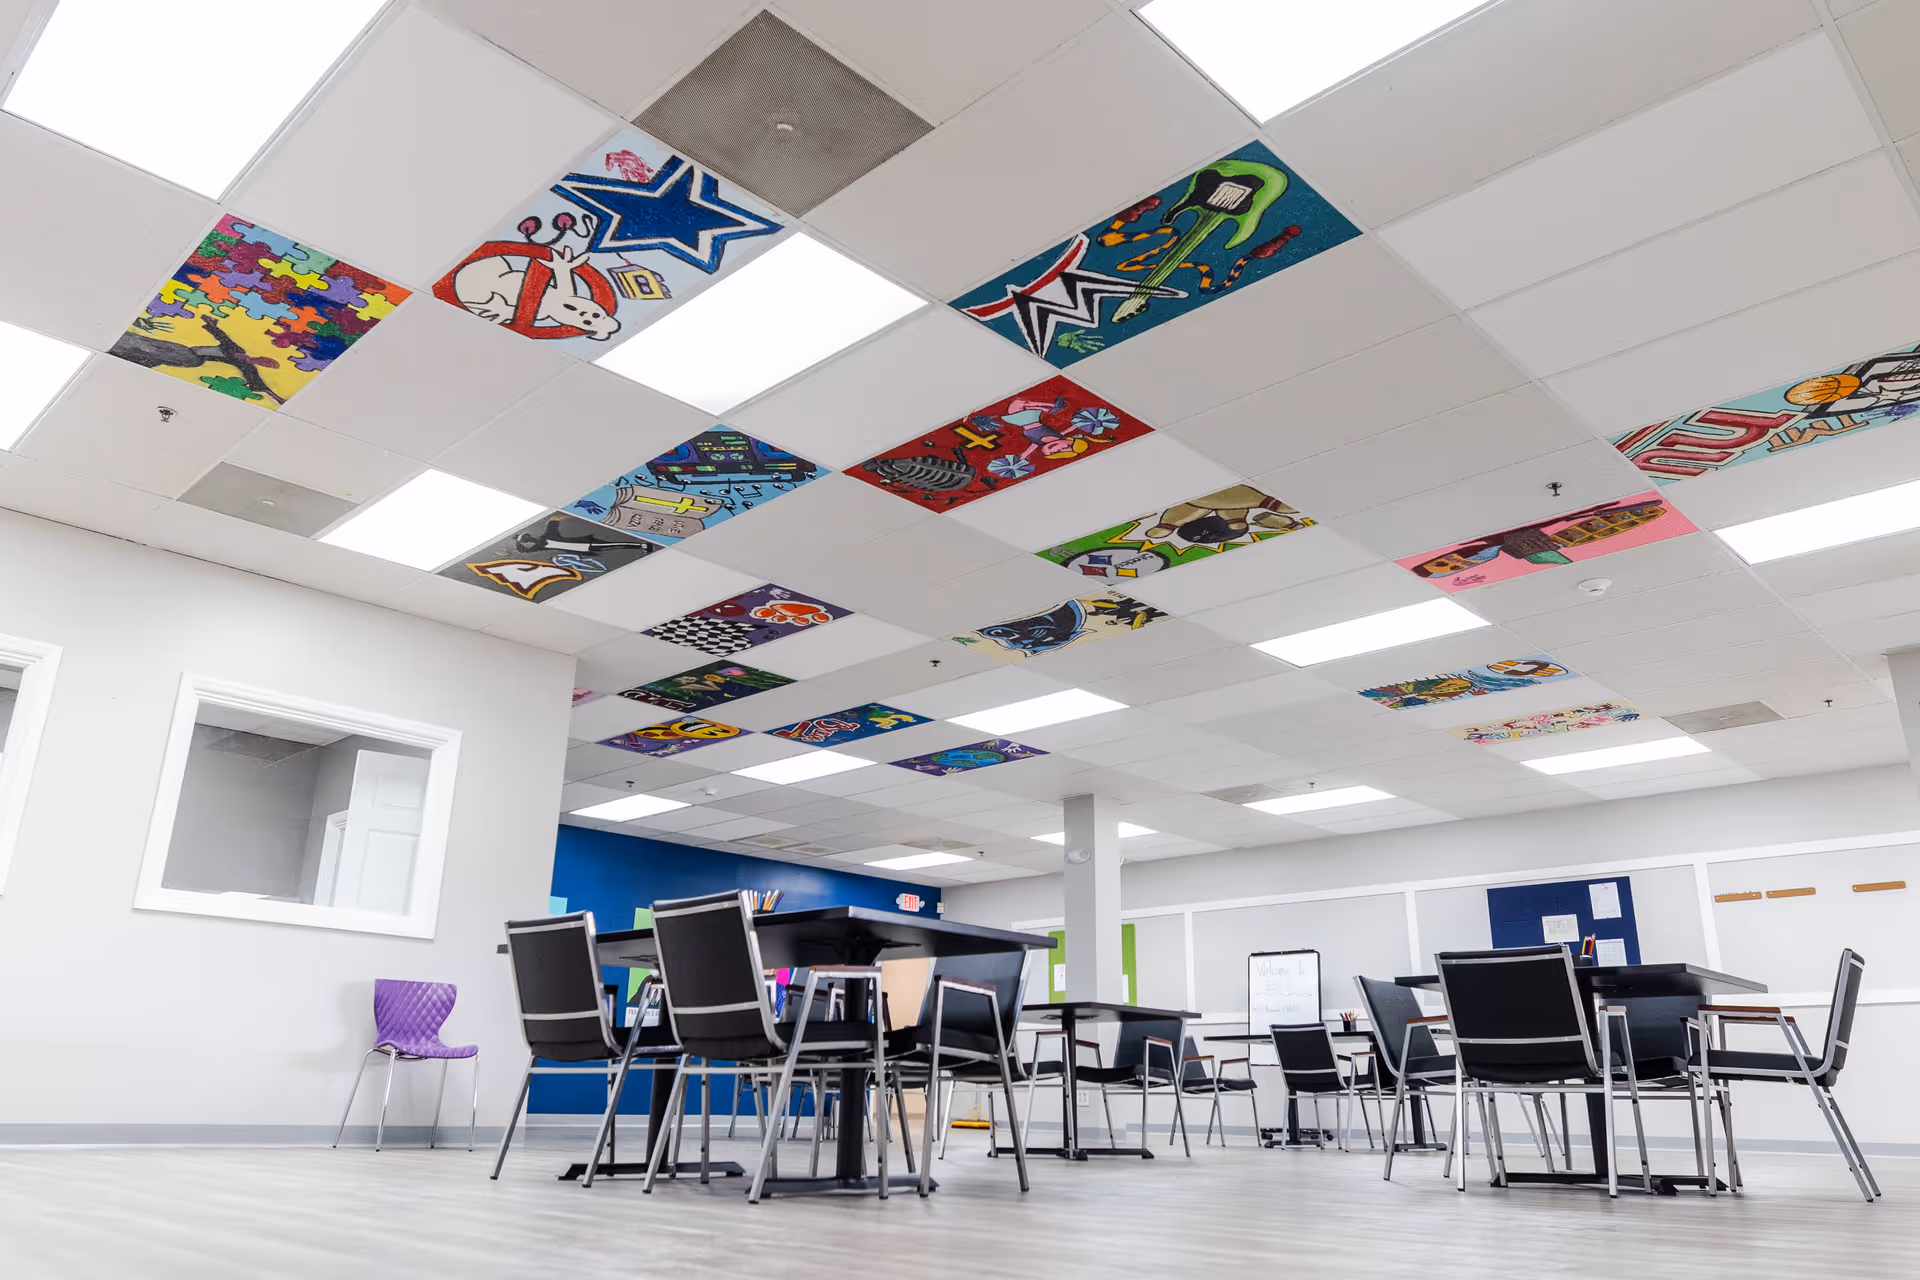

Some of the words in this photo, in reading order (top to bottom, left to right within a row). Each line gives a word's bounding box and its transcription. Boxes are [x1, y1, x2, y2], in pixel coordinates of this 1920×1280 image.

[1767, 414, 1869, 452] TMT
[1113, 553, 1154, 569] Steelers
[904, 895, 917, 911] EXIT
